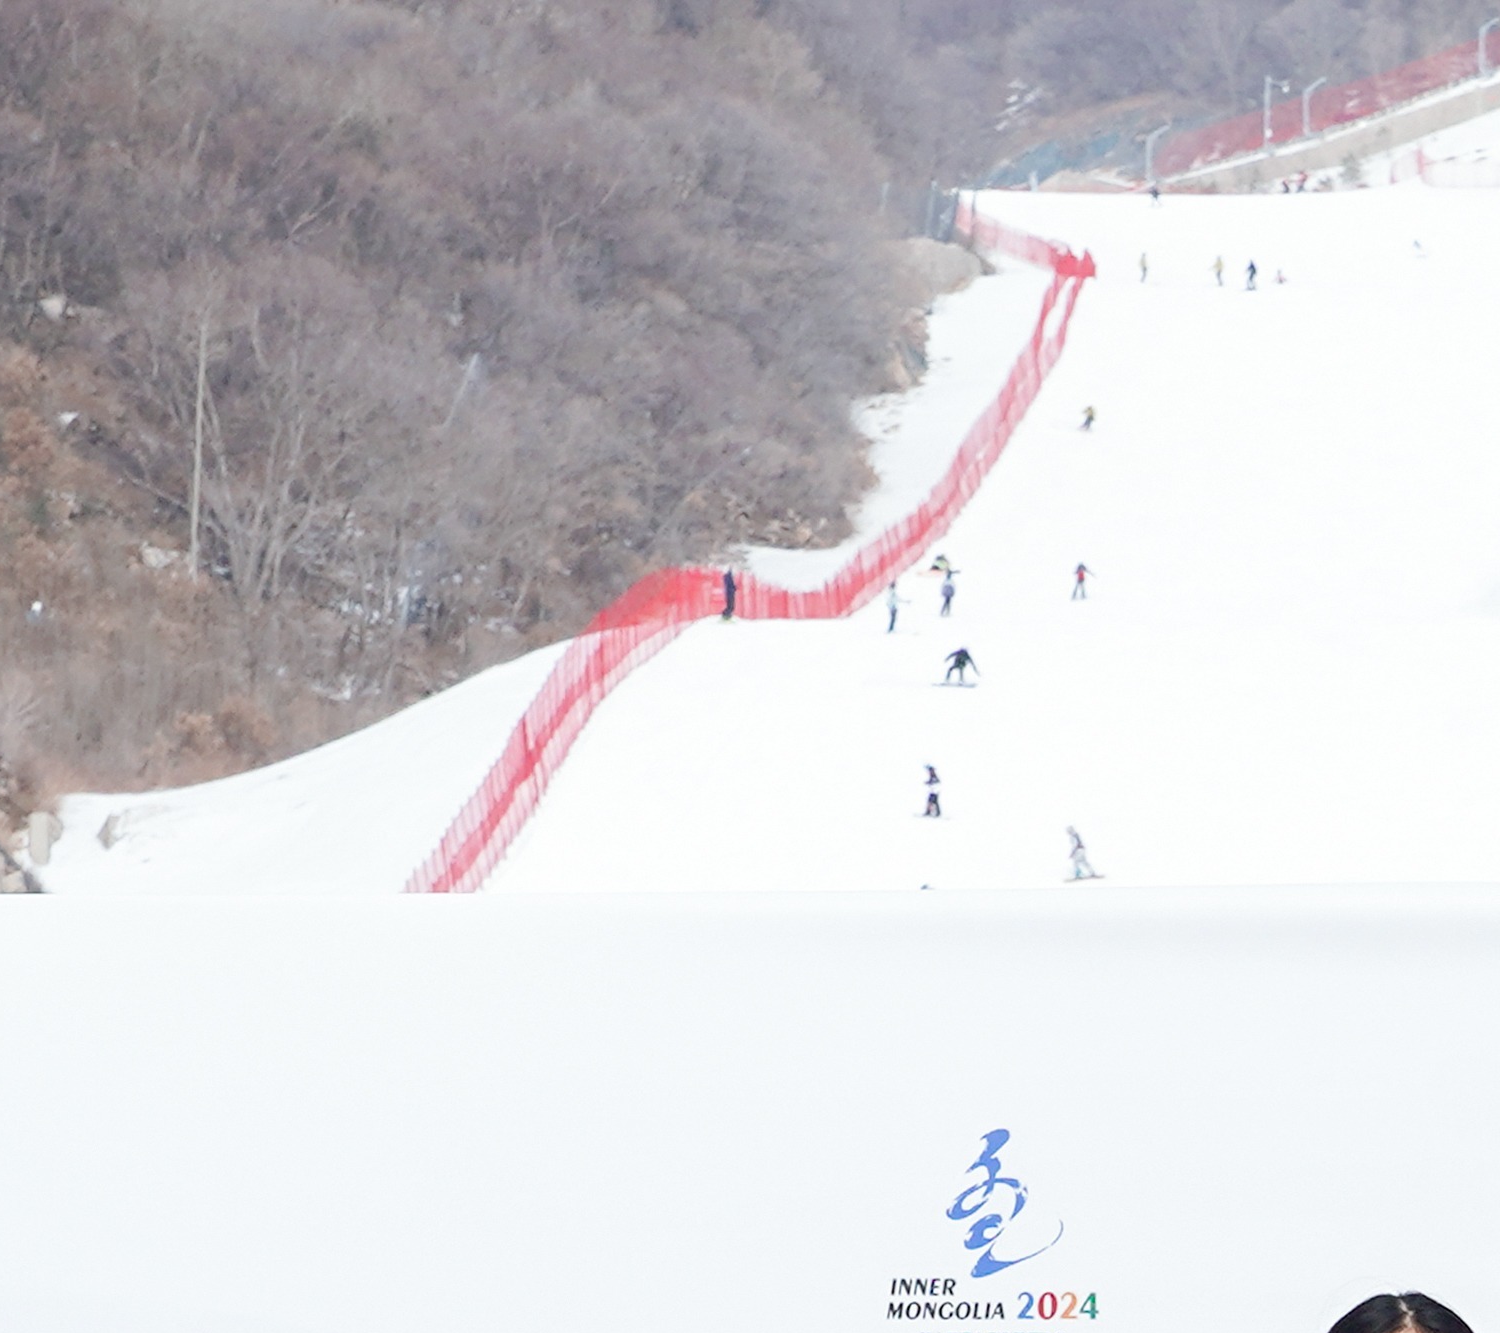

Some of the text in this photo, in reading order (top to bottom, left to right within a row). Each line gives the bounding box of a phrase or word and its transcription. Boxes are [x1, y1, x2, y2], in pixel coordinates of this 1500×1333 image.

[890, 1278, 957, 1296] INNER
[886, 1291, 1099, 1320] MONGOLIA 2024
